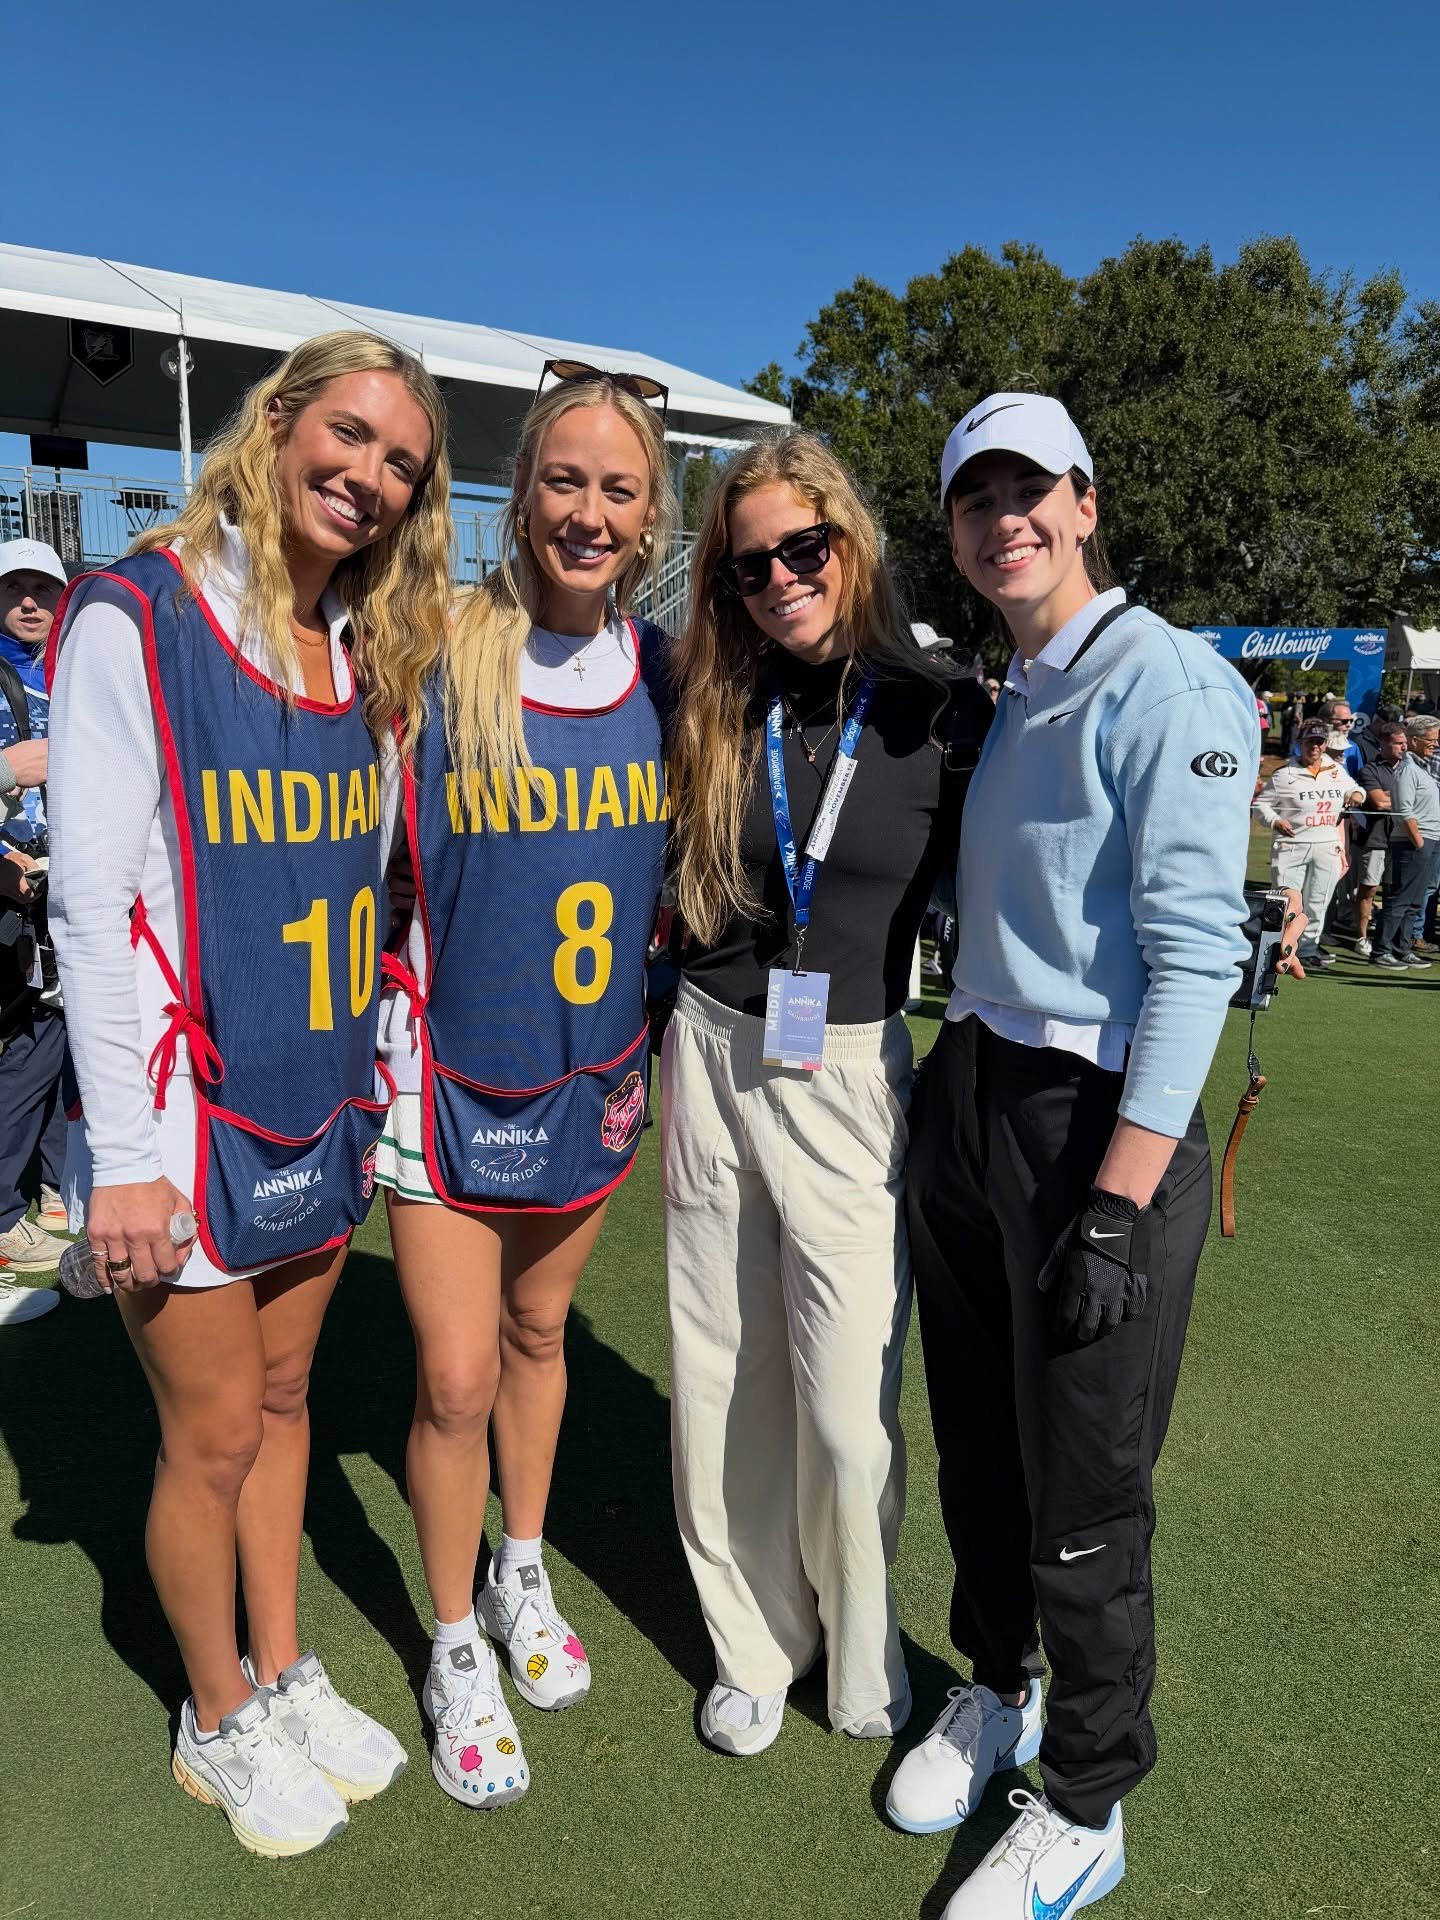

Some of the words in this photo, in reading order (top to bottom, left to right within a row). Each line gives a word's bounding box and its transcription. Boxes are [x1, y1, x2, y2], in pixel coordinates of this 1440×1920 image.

[1242, 631, 1332, 671] Chillounge
[771, 748, 782, 790] GAINBRIDGE
[828, 772, 850, 815] NOVEMBER
[1299, 789, 1342, 801] FEVER
[1317, 801, 1331, 813] 22
[283, 886, 375, 1030] 10
[554, 881, 613, 1004] 8
[768, 984, 781, 1031] MEDIA
[788, 997, 822, 1007] ANNIKA
[471, 1126, 549, 1145] ANNIKA
[253, 1167, 322, 1198] ANNIKA
[470, 1156, 549, 1182] GAINBRIDGE
[253, 1198, 322, 1231] GAINBRIDGE
